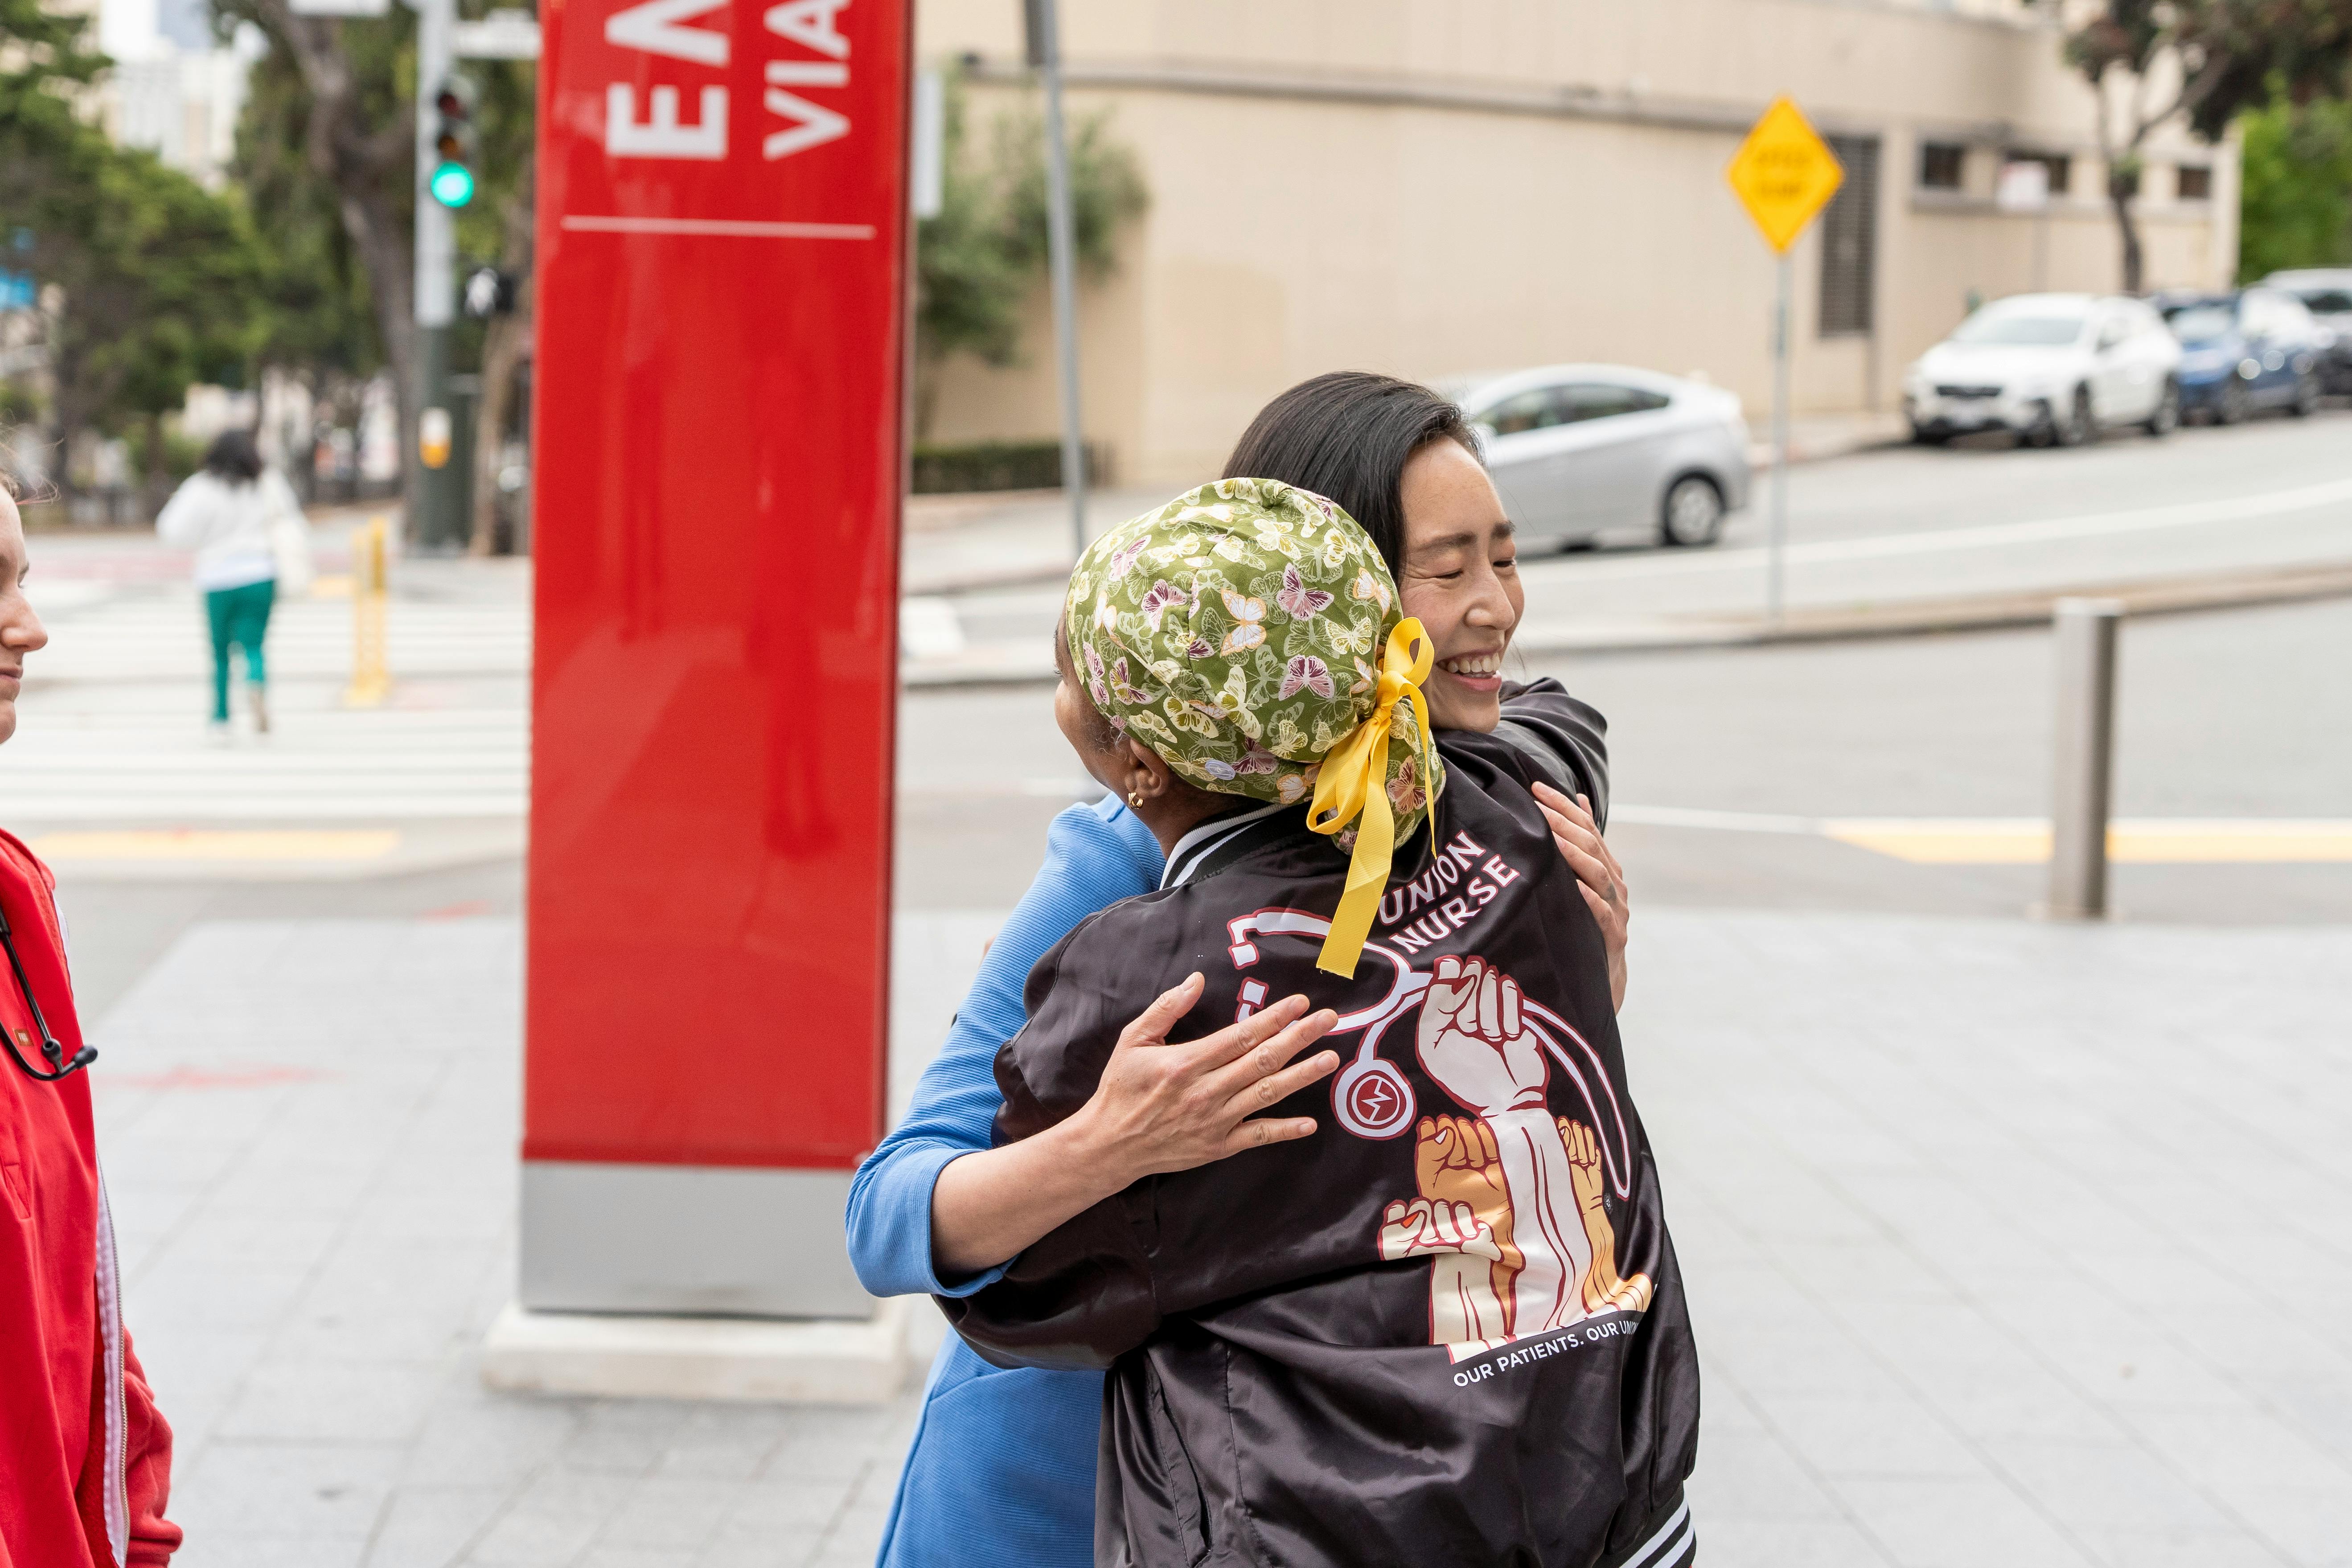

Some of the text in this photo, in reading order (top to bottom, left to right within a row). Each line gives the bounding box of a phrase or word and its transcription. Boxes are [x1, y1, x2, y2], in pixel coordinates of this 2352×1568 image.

[763, 0, 852, 161] VIA
[1378, 829, 1486, 926] UNION
[1389, 854, 1519, 954] NURSE
[1453, 1363, 1494, 1387] OUR
[1496, 1334, 1584, 1371] PATIENTS.
[1586, 1322, 1619, 1341] OUR
